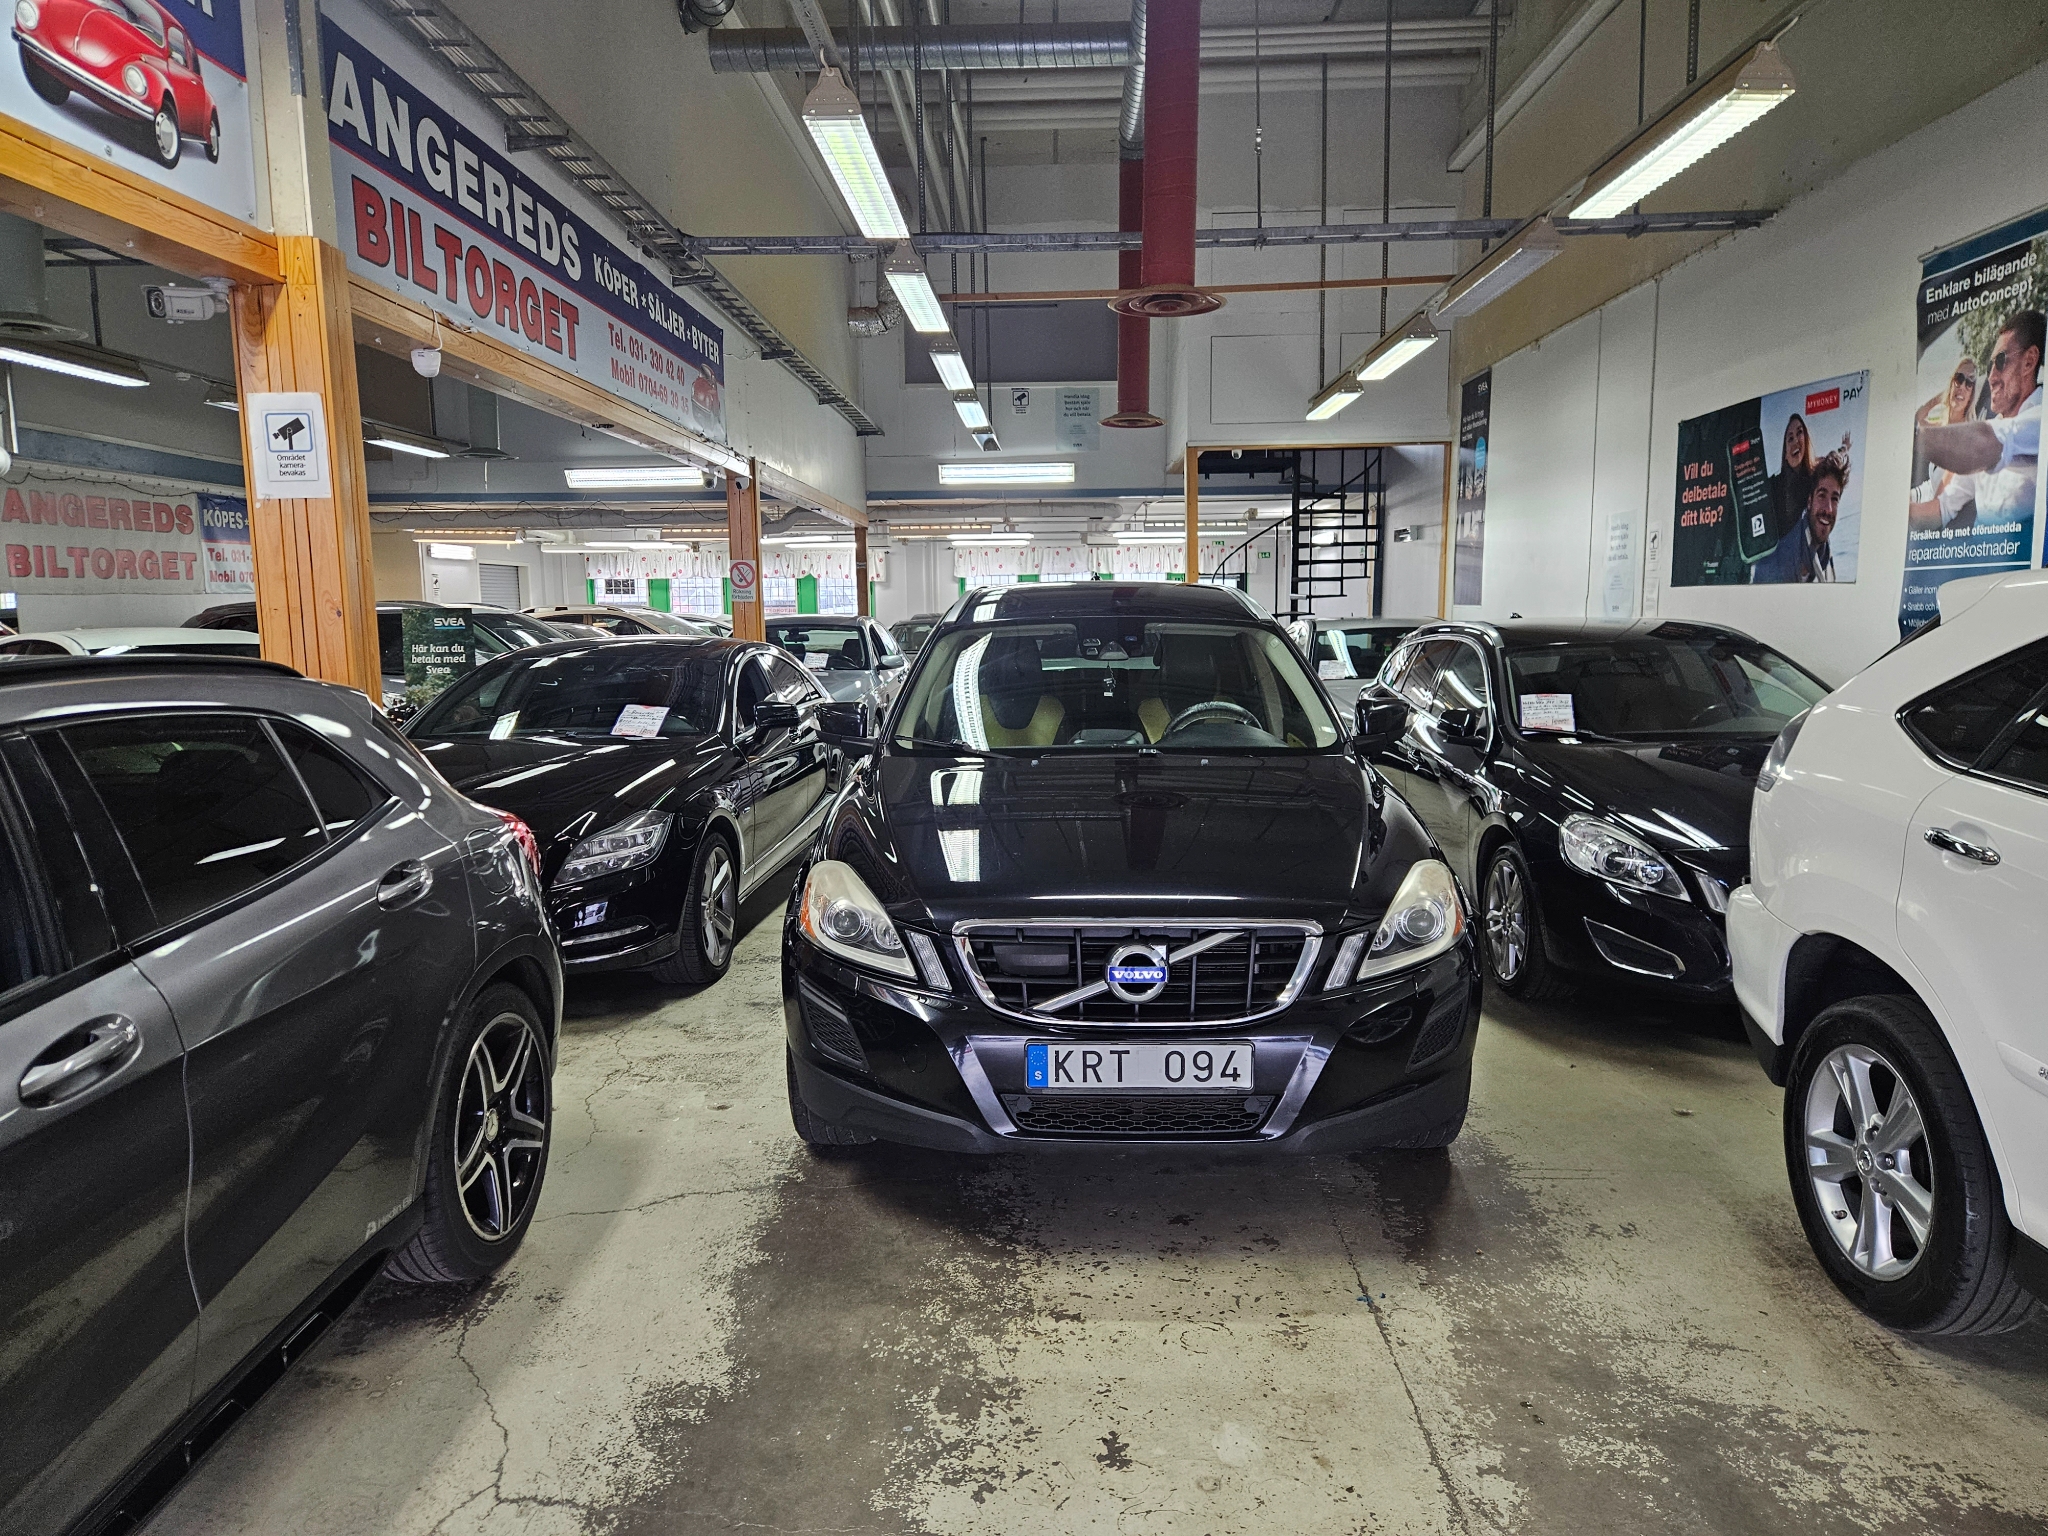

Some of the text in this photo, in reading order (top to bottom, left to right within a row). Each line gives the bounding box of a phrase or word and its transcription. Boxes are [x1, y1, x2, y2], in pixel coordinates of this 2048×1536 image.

[329, 52, 582, 282] ANGEREDS
[351, 174, 580, 362] BILTORGET
[1926, 252, 2037, 303] Enklare bilägande
[593, 253, 720, 365] KÖPER SÄLJER BYTER
[1927, 275, 2034, 325] med AutoConcept
[608, 321, 685, 386] Tel. 031- 330 42 40
[611, 357, 636, 389] Mobil
[638, 372, 668, 406] 0704-69
[670, 392, 679, 410] 39
[1807, 386, 1863, 410] MYMONEY PAY
[1684, 460, 1713, 480] Vill du
[1682, 482, 1727, 503] delbetala
[1, 487, 195, 535] ANGEREDS
[203, 507, 244, 530] KÖPES
[1681, 505, 1724, 527] ditt köp?
[1910, 521, 2022, 541] Försäkra dig mot oförutsedda
[5, 543, 197, 581] BILTORGET
[207, 547, 228, 562] Tel.
[1908, 539, 2021, 564] reparationskostnader
[209, 570, 236, 584] Mobil
[1908, 585, 1923, 594] Gäller
[1907, 602, 1924, 611] Snabb
[1925, 602, 1937, 611] och
[434, 617, 466, 626] SVEA
[411, 643, 464, 653] Här kan du
[411, 654, 466, 664] betala med
[426, 665, 451, 674] Svea
[1112, 970, 1164, 980] VOLVO
[1034, 1050, 1241, 1083] S KRT 094
